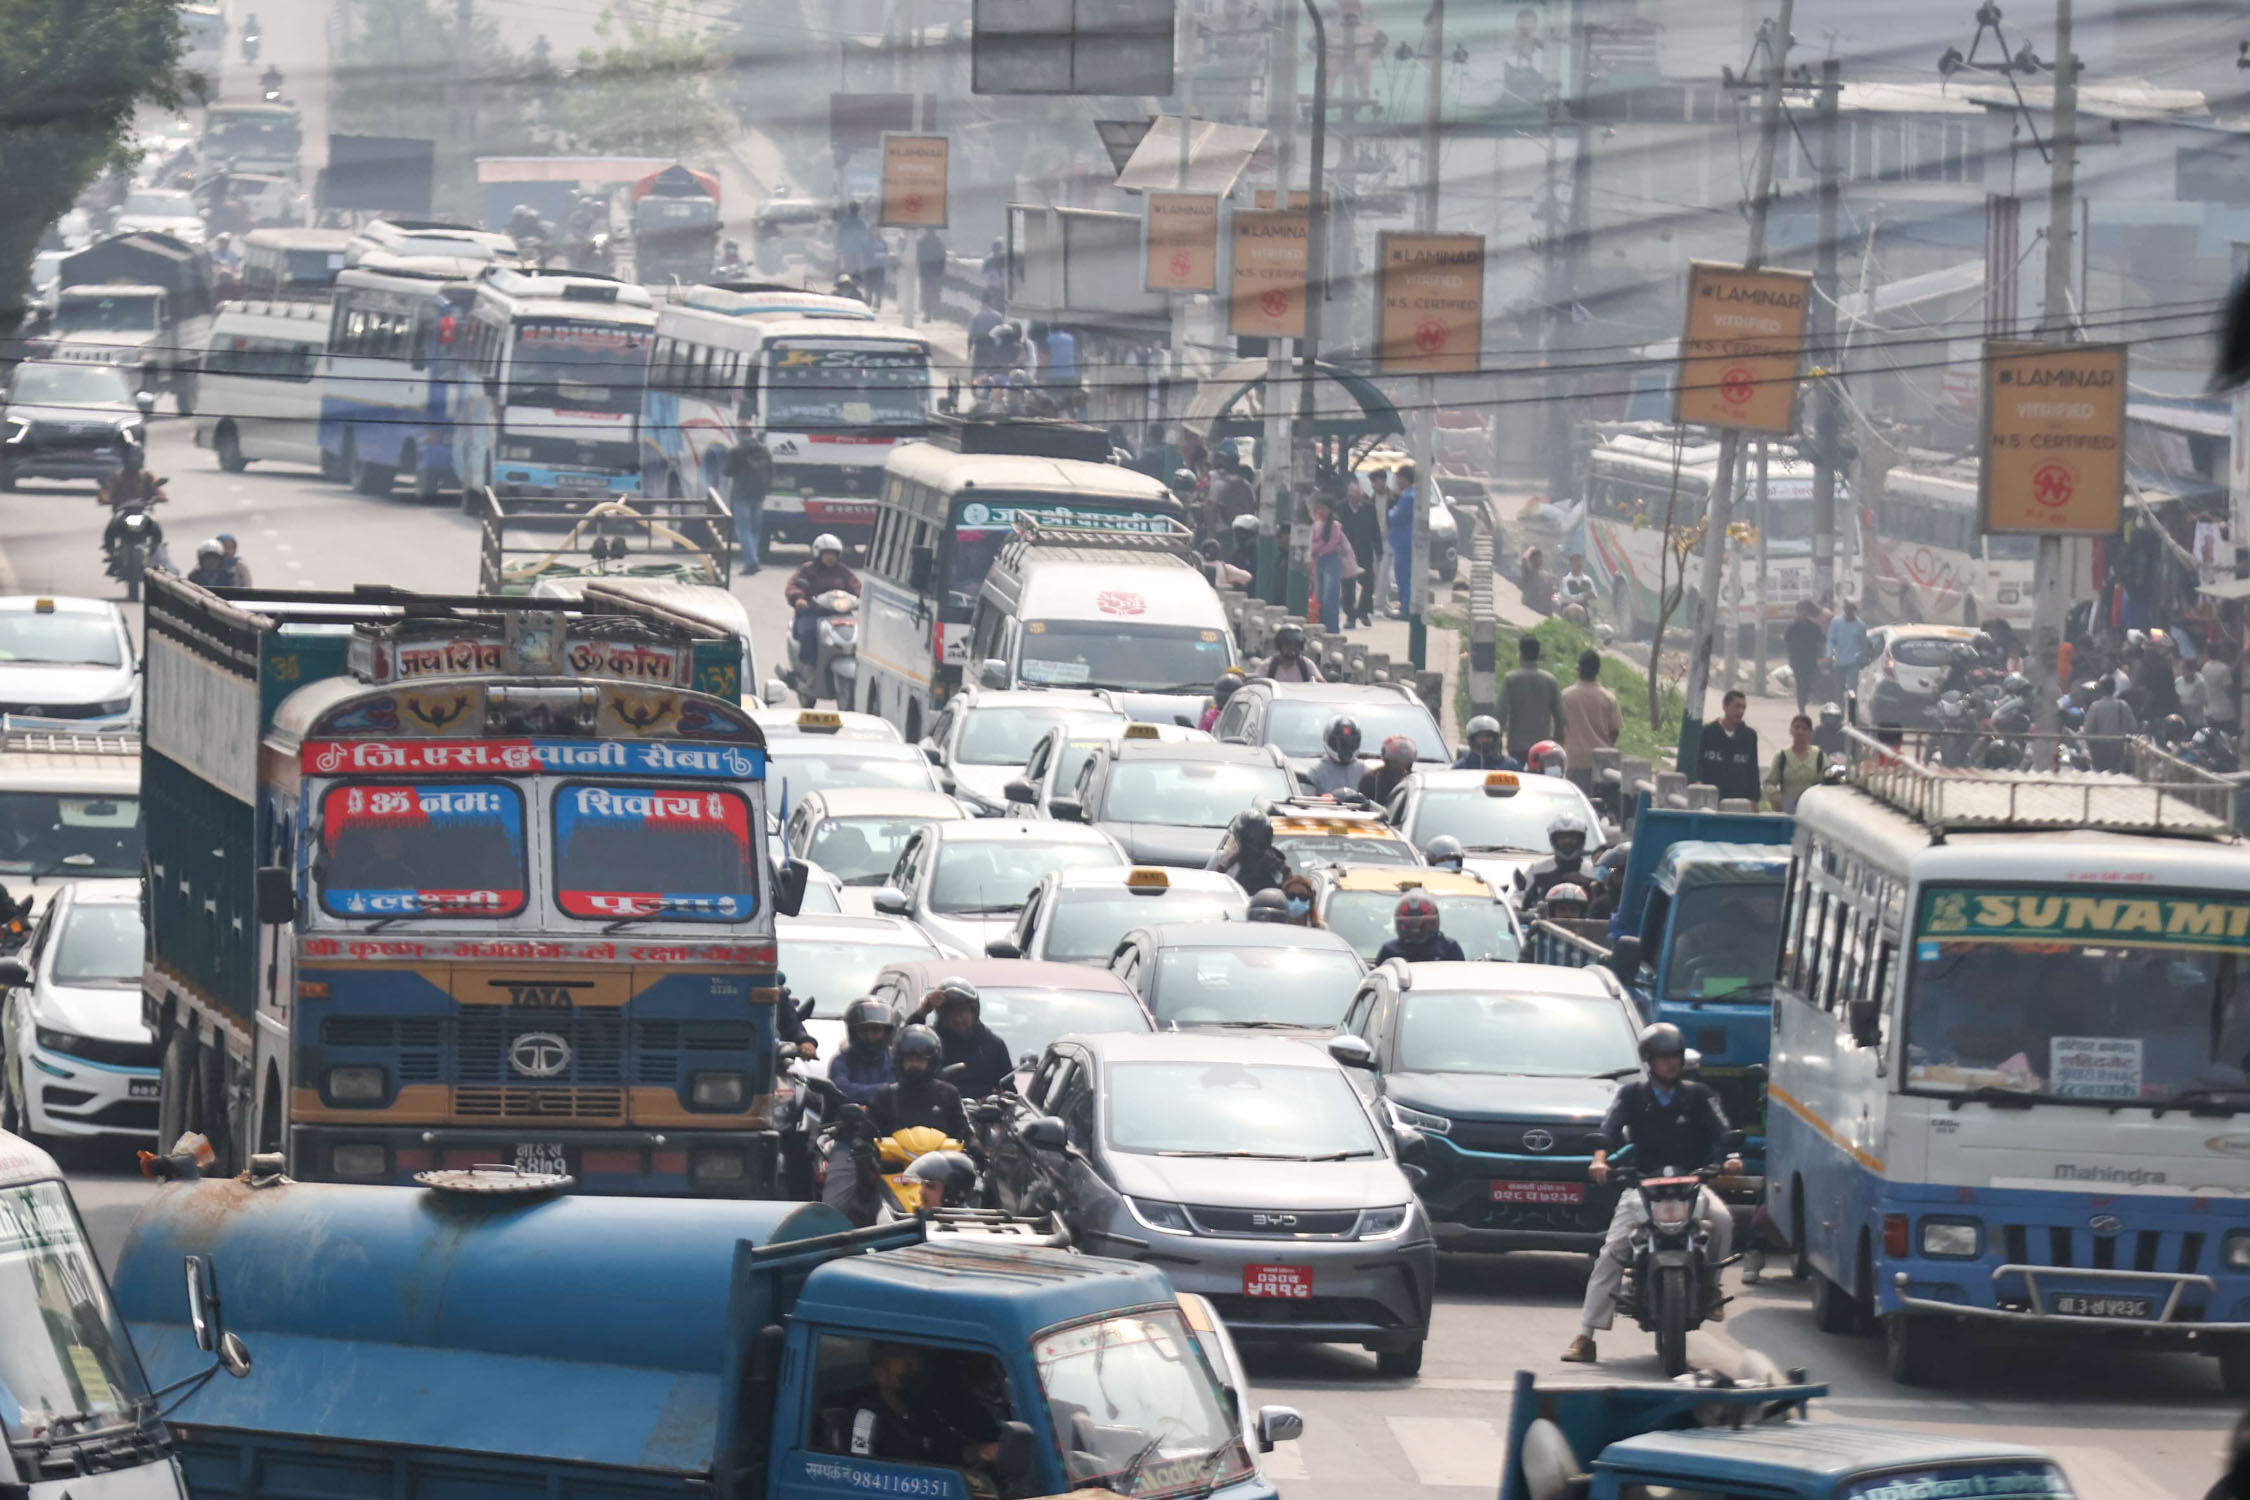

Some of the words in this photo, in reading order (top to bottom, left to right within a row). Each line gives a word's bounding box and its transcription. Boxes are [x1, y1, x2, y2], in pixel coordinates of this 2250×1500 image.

[1251, 225, 1307, 239] LAMINA
[1404, 247, 1480, 265] LAMINAR
[1716, 285, 1800, 309] LAMINAR
[1713, 312, 1782, 333] VITRIFIED
[2016, 368, 2115, 388] LAMINAR
[2016, 402, 2095, 419] VITRIFIED
[2031, 433, 2117, 451] CERTIFIED
[399, 649, 442, 677] जय
[446, 641, 502, 675] शिव
[370, 792, 410, 813] ॐ
[418, 792, 500, 813] नमः
[576, 787, 701, 818] शिवाय
[305, 938, 338, 957] श्री
[507, 986, 574, 1008] TATA
[2054, 1164, 2168, 1185] Mahindra
[1252, 1214, 1298, 1227] BYD
[852, 1469, 949, 1497] 9841169351
